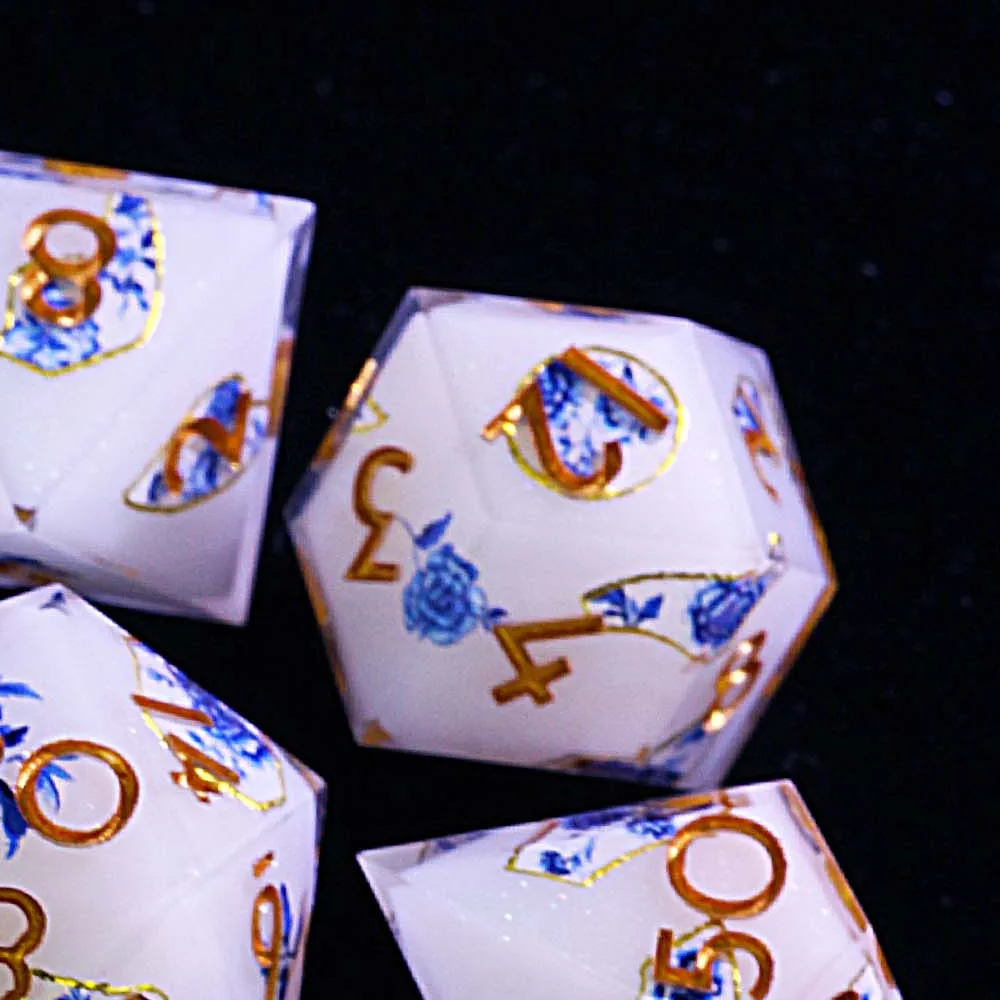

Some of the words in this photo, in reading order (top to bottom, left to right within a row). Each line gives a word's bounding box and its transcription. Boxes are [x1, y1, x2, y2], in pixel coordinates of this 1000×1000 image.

[23, 208, 117, 329] 8
[163, 391, 253, 497] 2
[480, 344, 669, 489] 12
[344, 446, 415, 582] 3
[490, 614, 604, 707] 4
[131, 694, 241, 804] 14
